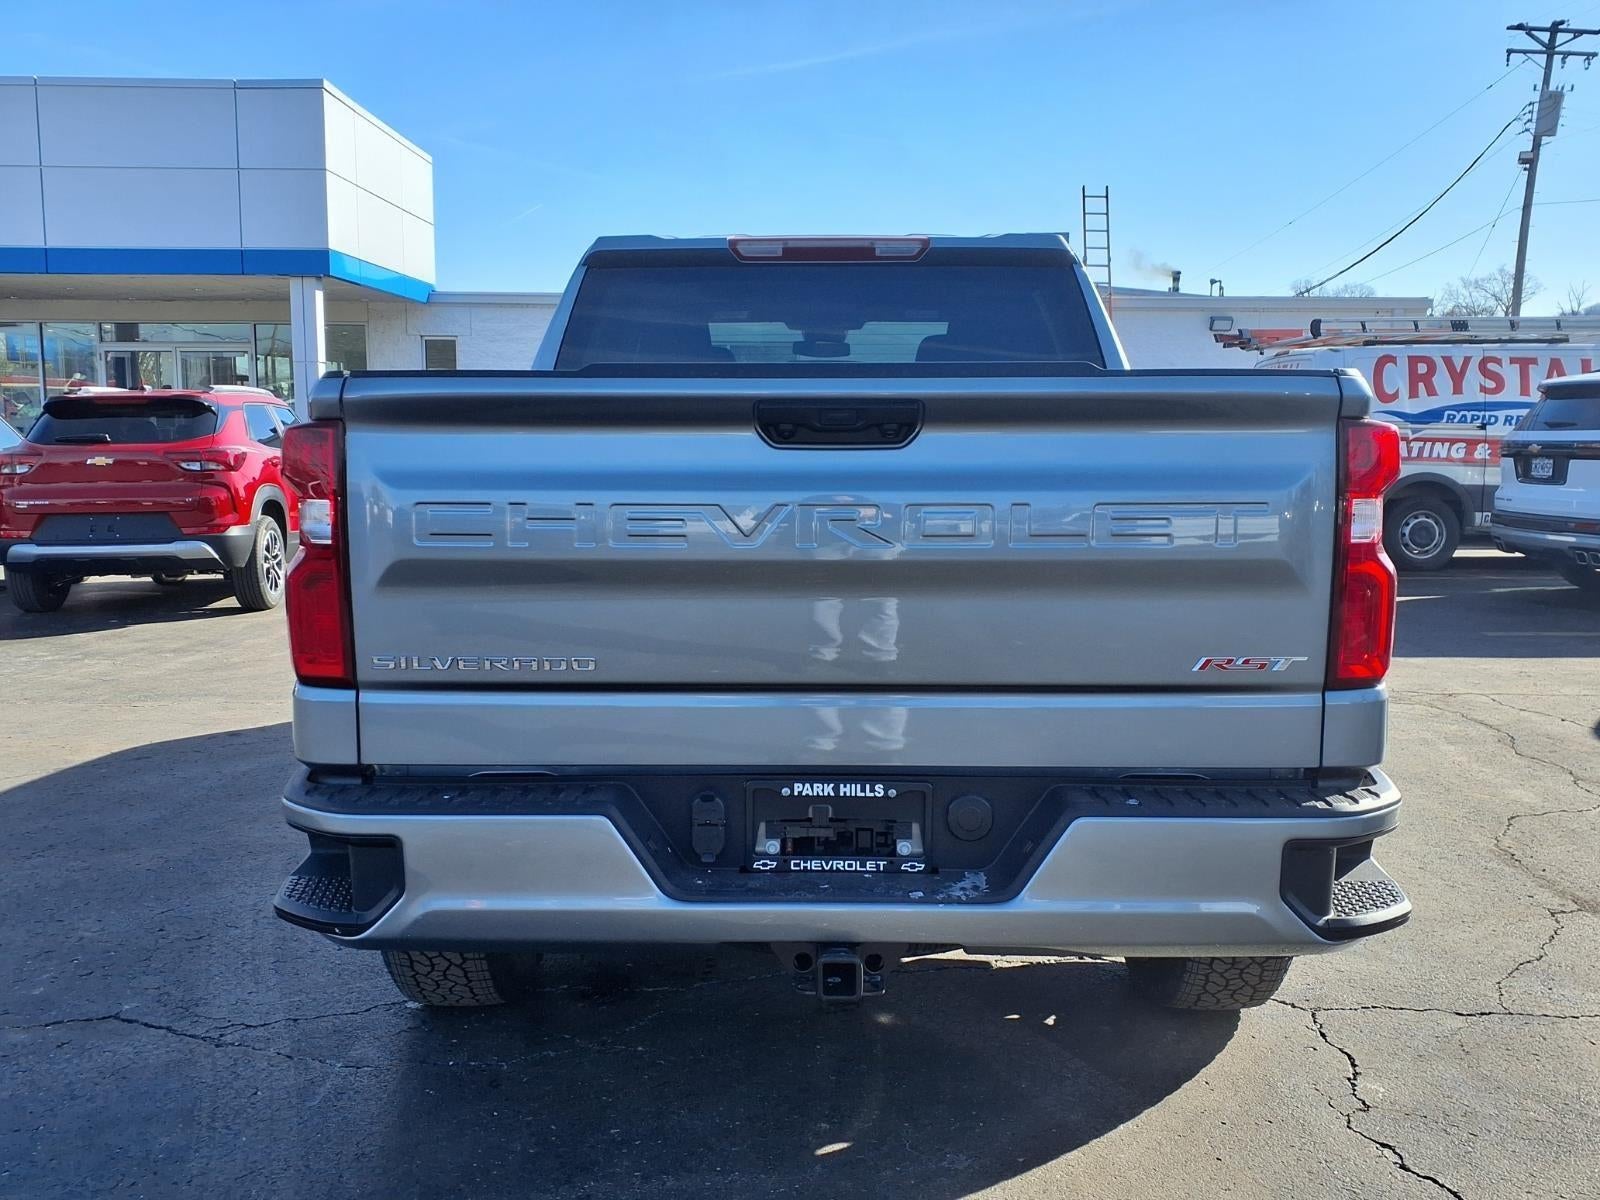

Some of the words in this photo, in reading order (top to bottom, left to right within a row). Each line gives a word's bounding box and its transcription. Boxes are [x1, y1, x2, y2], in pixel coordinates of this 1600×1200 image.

[1443, 411, 1499, 426] RAPID
[1474, 442, 1492, 459] &
[412, 502, 1270, 549] CHEVROLET
[371, 655, 597, 671] SILVERADO
[1191, 656, 1309, 672] RST
[793, 782, 835, 796] PARK
[839, 783, 885, 797] HILLS
[790, 859, 887, 871] CHEVROLET
